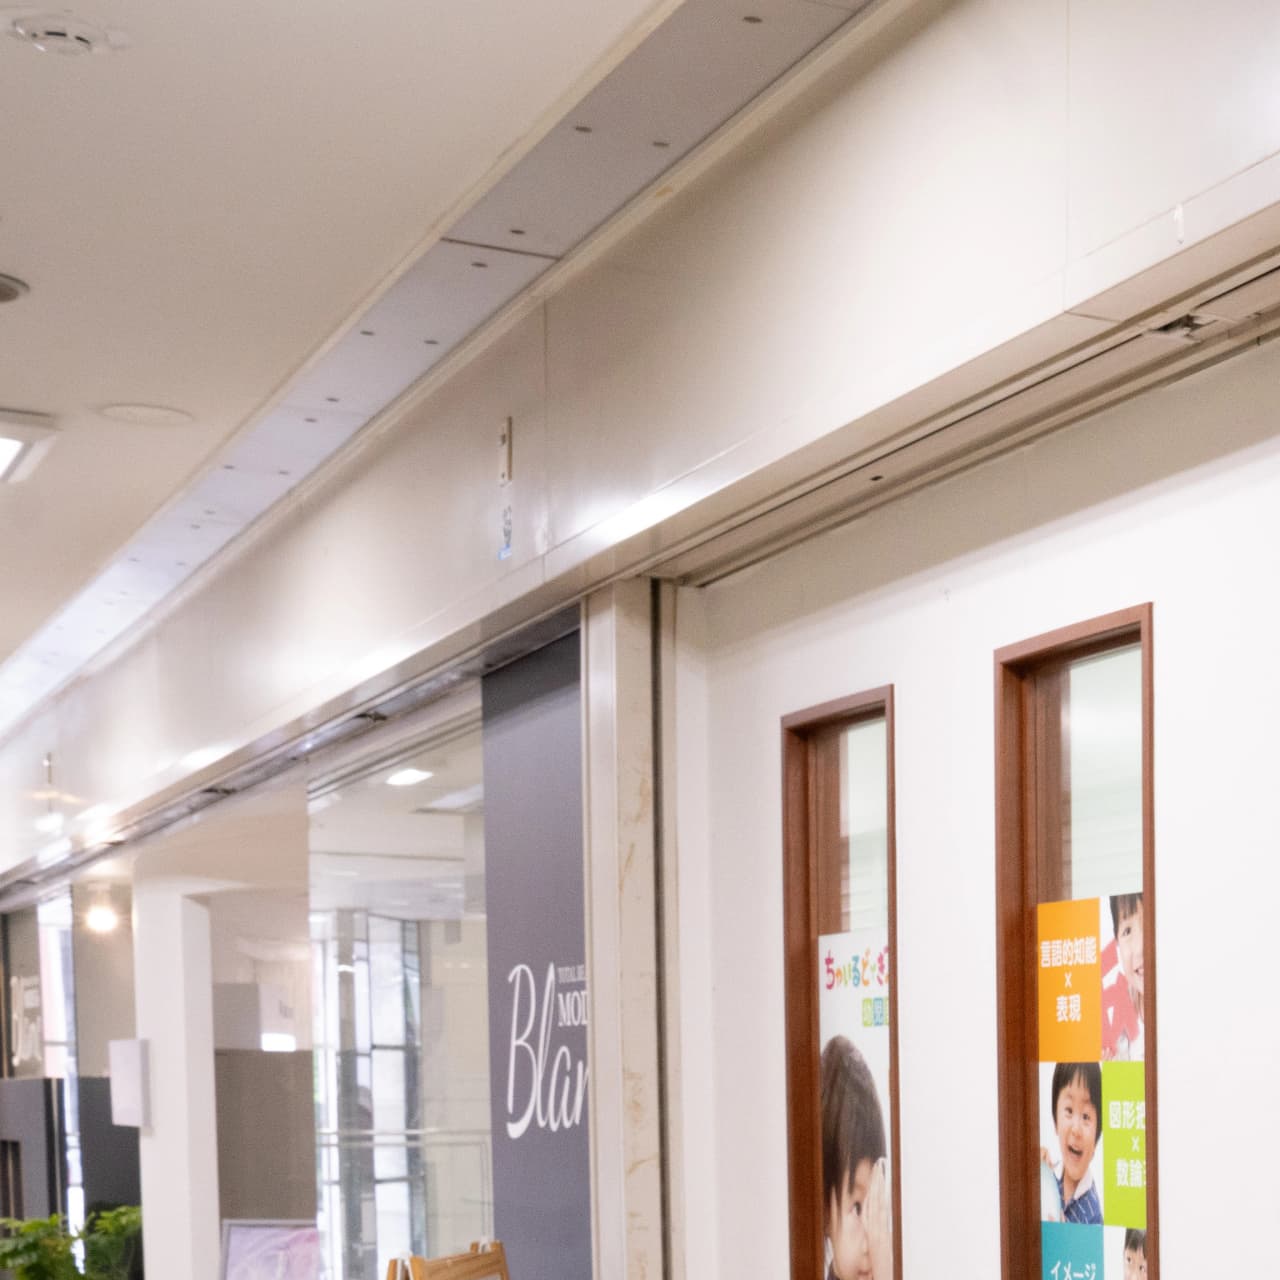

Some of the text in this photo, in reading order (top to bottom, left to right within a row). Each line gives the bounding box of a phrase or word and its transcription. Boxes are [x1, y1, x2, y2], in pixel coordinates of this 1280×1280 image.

[824, 946, 889, 990] ちゃいるどぎ
[1056, 993, 1082, 1023] 表現
[1116, 1159, 1146, 1188] 数論
